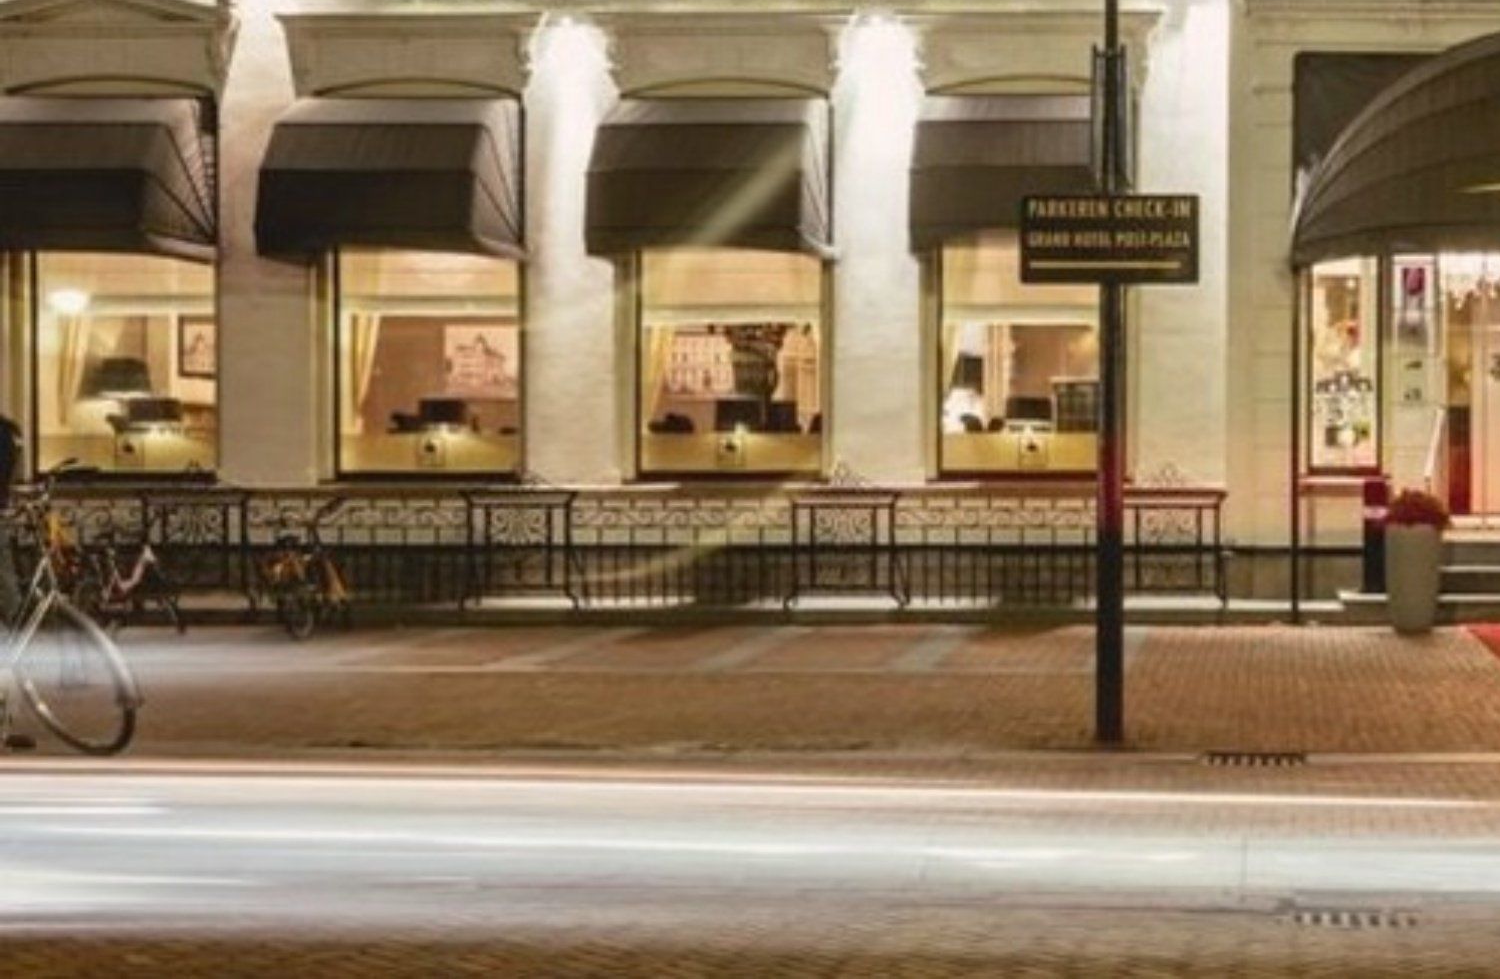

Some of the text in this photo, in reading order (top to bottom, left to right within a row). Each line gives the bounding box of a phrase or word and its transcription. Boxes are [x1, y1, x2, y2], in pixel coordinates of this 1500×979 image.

[1028, 199, 1191, 218] PARKEREN CHECK-IN
[1029, 231, 1191, 248] GRAND HOTEL POST-PLAZA
